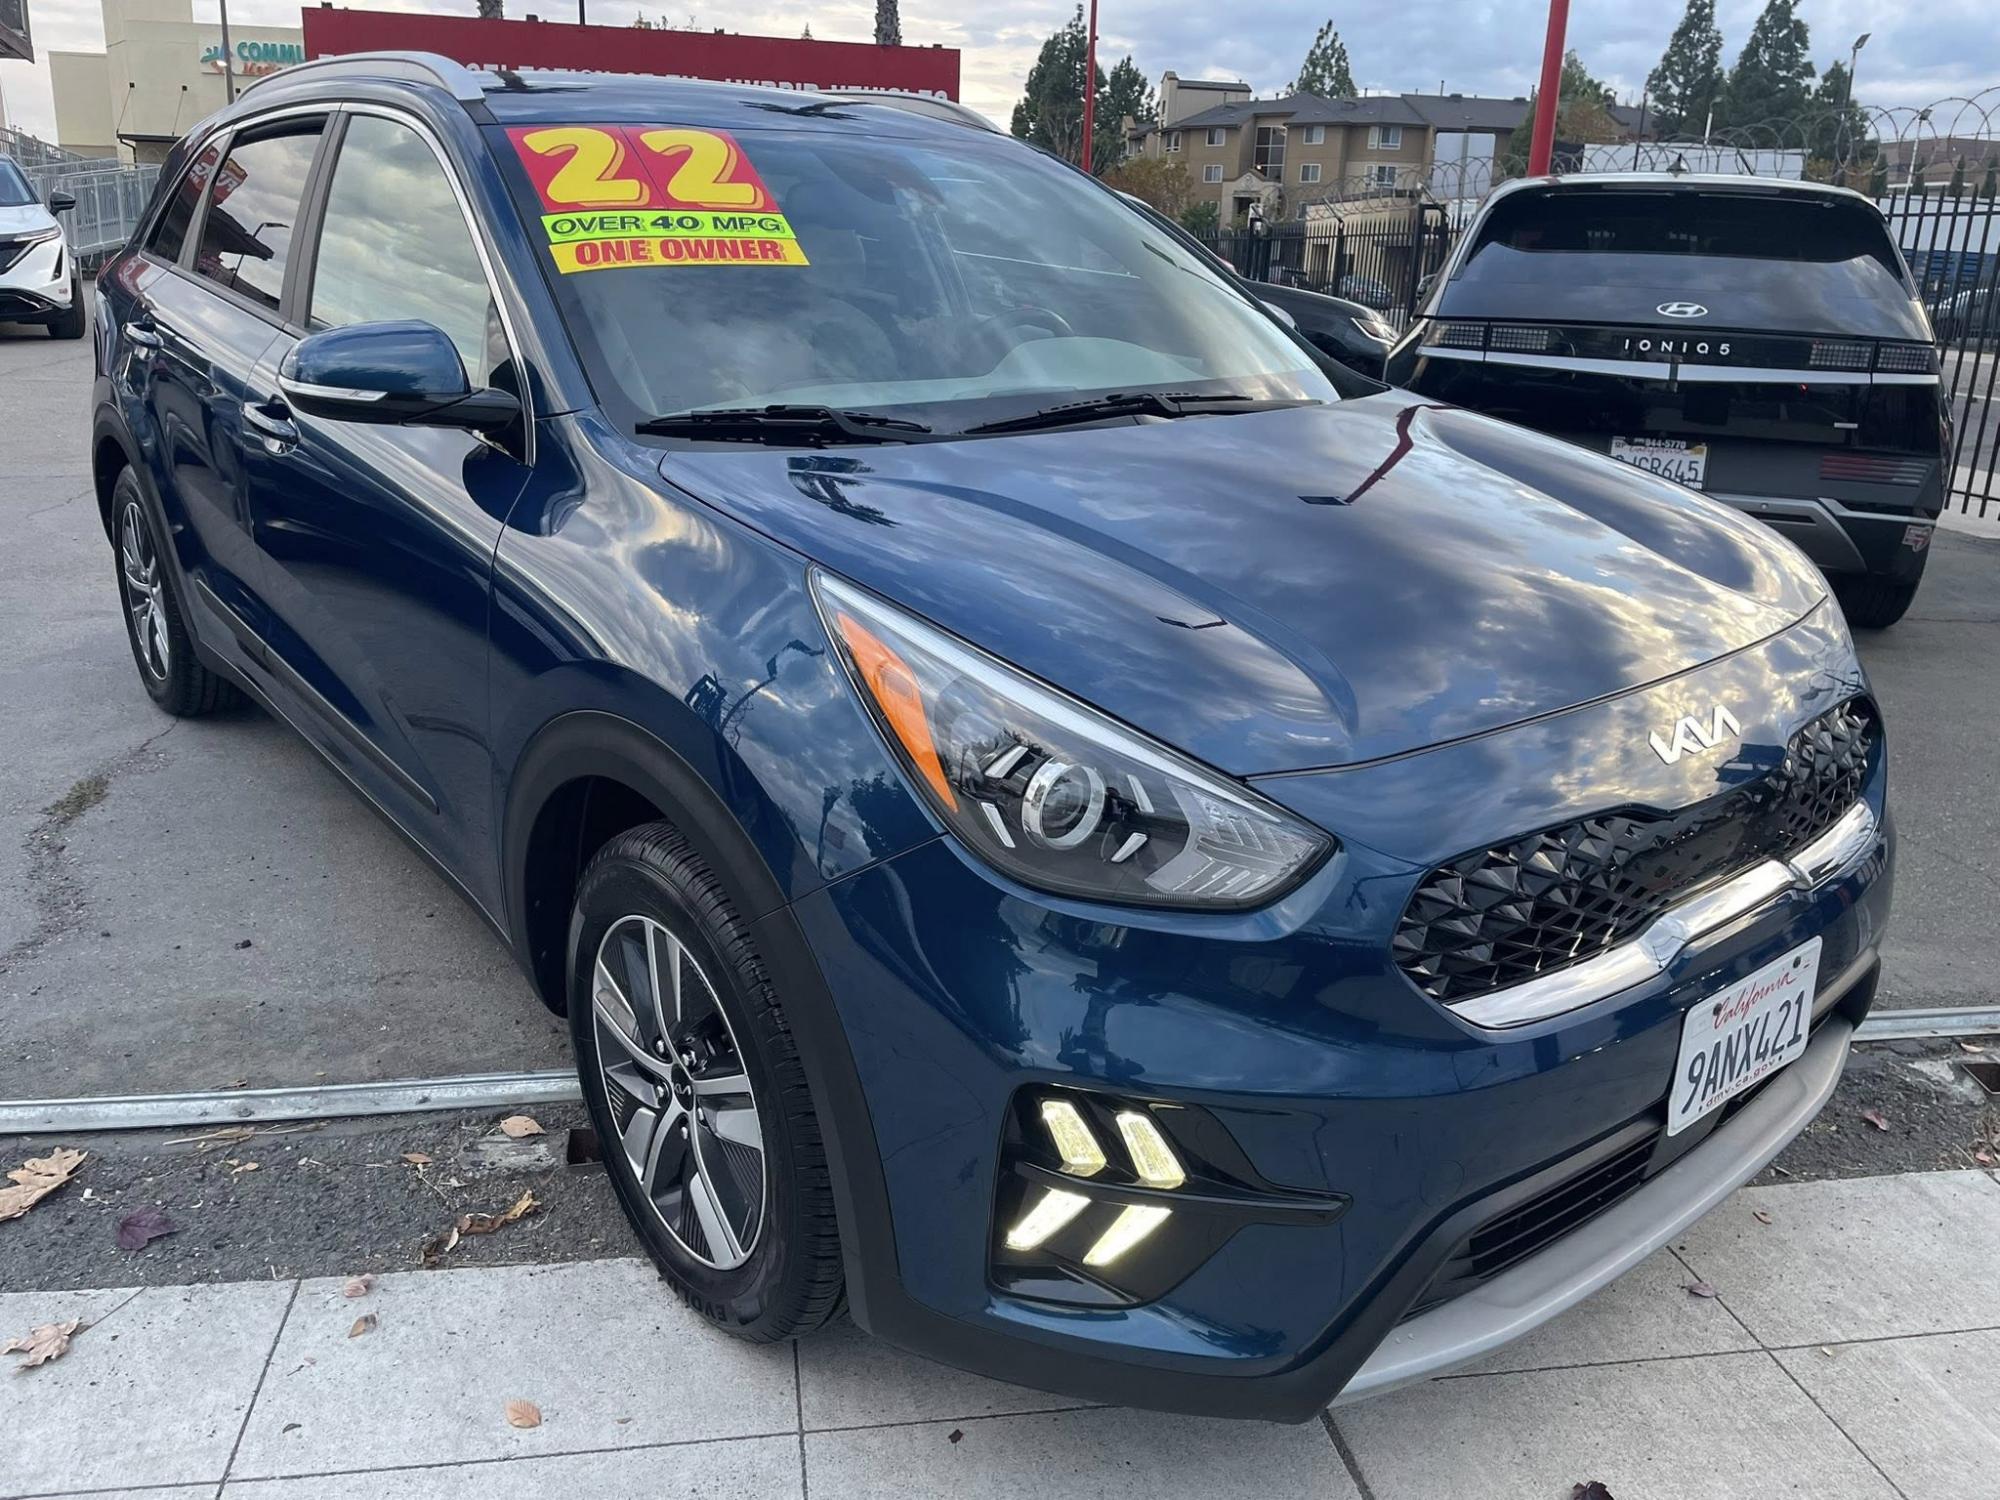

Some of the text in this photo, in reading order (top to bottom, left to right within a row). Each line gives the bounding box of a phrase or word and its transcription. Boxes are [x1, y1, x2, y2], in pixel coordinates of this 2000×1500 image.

[522, 127, 764, 208] 22
[551, 216, 784, 236] OVER 40 MPG
[575, 239, 784, 266] ONE OWNER
[1647, 703, 1741, 765] KIA
[1714, 967, 1798, 1030] California
[1681, 990, 1805, 1115] 9ANX421
[1705, 1059, 1776, 1107] dmv.ca.gov
